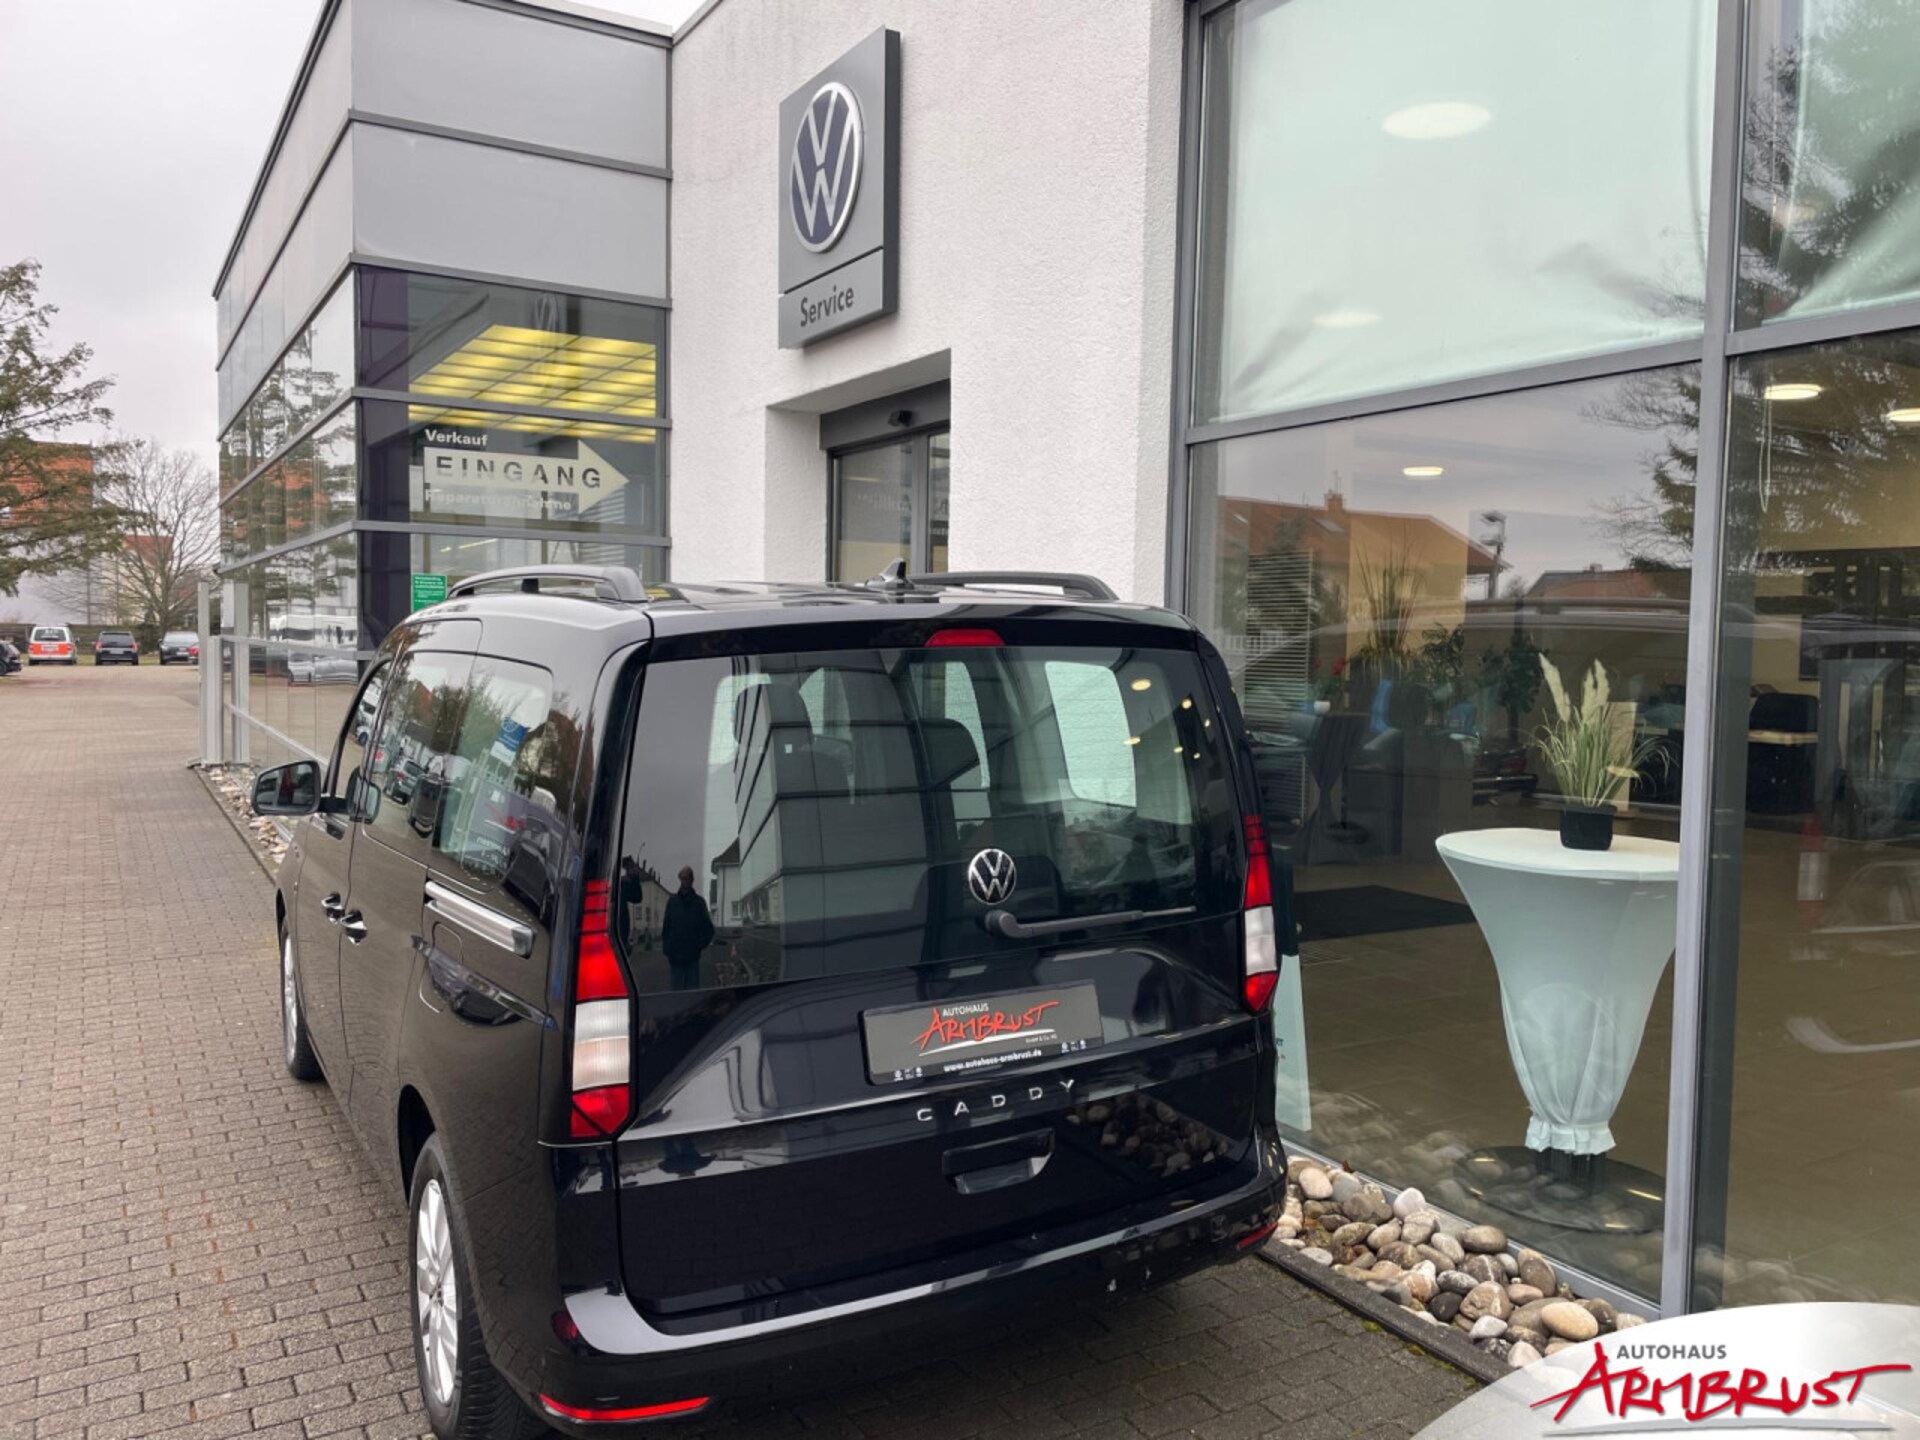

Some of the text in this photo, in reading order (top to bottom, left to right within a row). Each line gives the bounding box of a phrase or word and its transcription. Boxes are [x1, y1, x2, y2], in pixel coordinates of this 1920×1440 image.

[800, 286, 855, 327] Service
[425, 429, 488, 446] Verkauf
[436, 455, 600, 488] EINGANG
[911, 1001, 1060, 1050] ARMBRUST
[942, 1003, 989, 1016] AUTOHAUS
[917, 1079, 1074, 1121] CADDY
